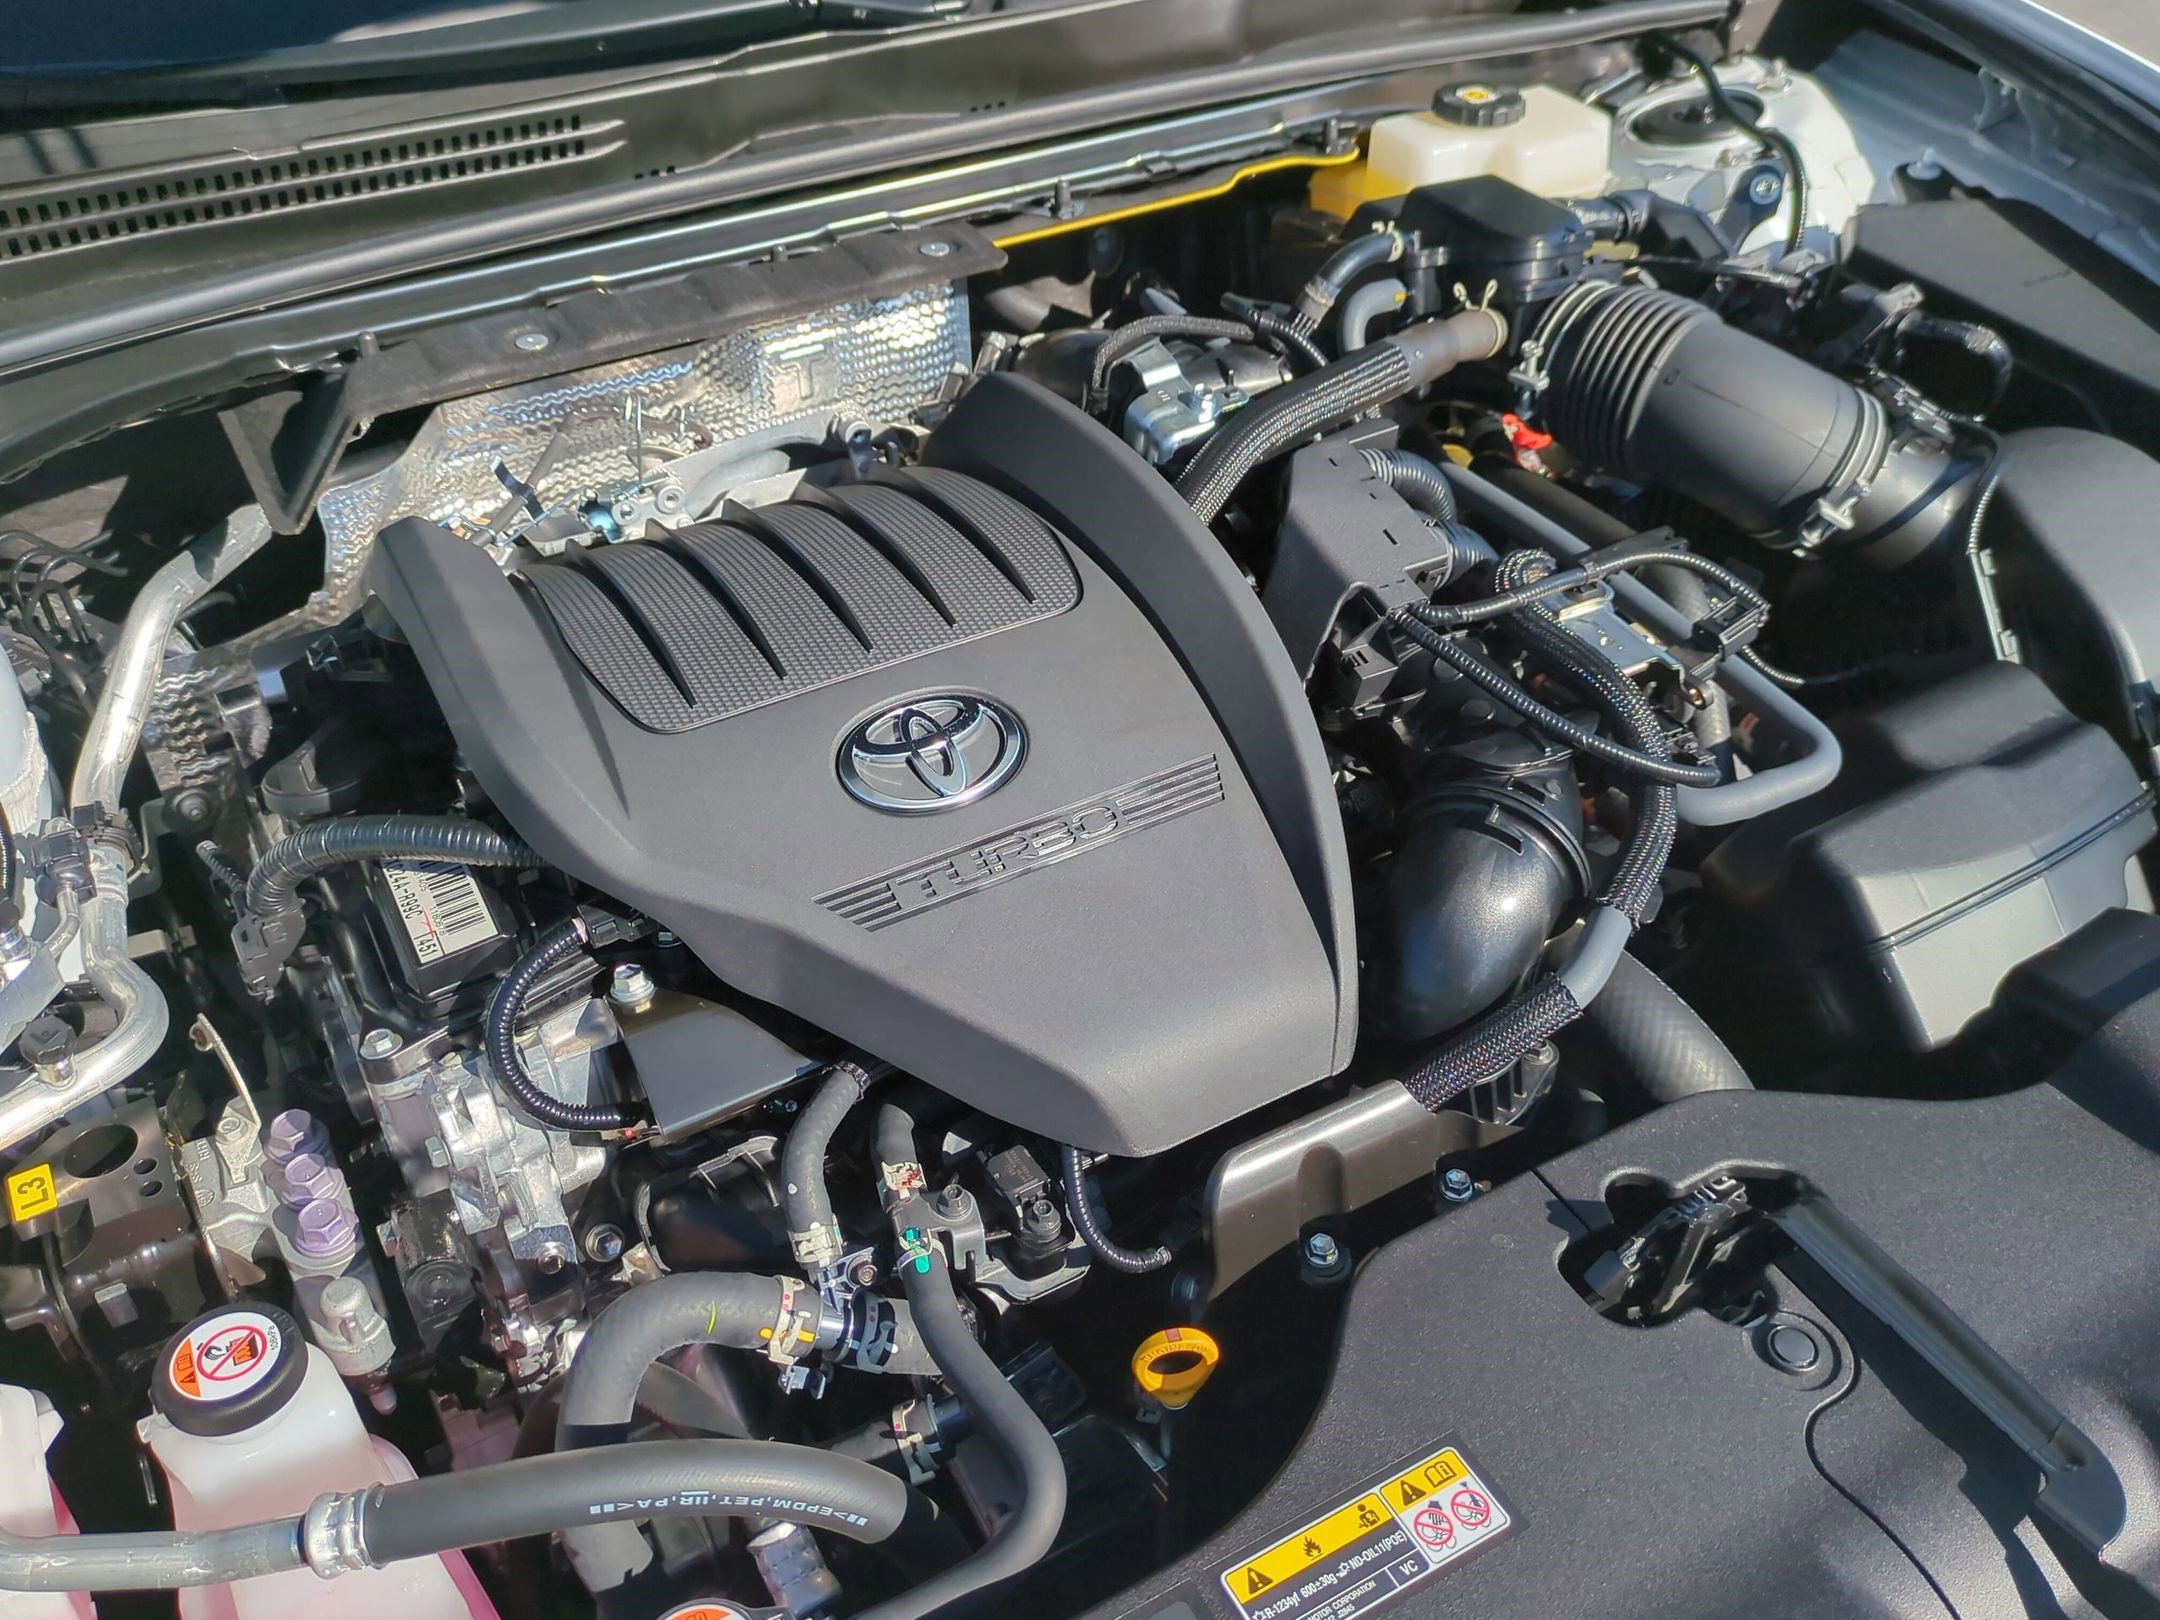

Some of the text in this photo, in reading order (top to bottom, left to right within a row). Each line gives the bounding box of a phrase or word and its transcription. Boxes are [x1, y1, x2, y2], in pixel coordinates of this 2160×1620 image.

[895, 805, 1119, 898] TURBO
[419, 938, 442, 959] 451
[16, 1176, 50, 1210] L3
[1300, 1573, 1338, 1598] 600±30g
[1347, 1529, 1408, 1571] ND-OIL11(POE)
[1398, 1558, 1419, 1576] VC
[1331, 1580, 1377, 1610] CORPORATION
